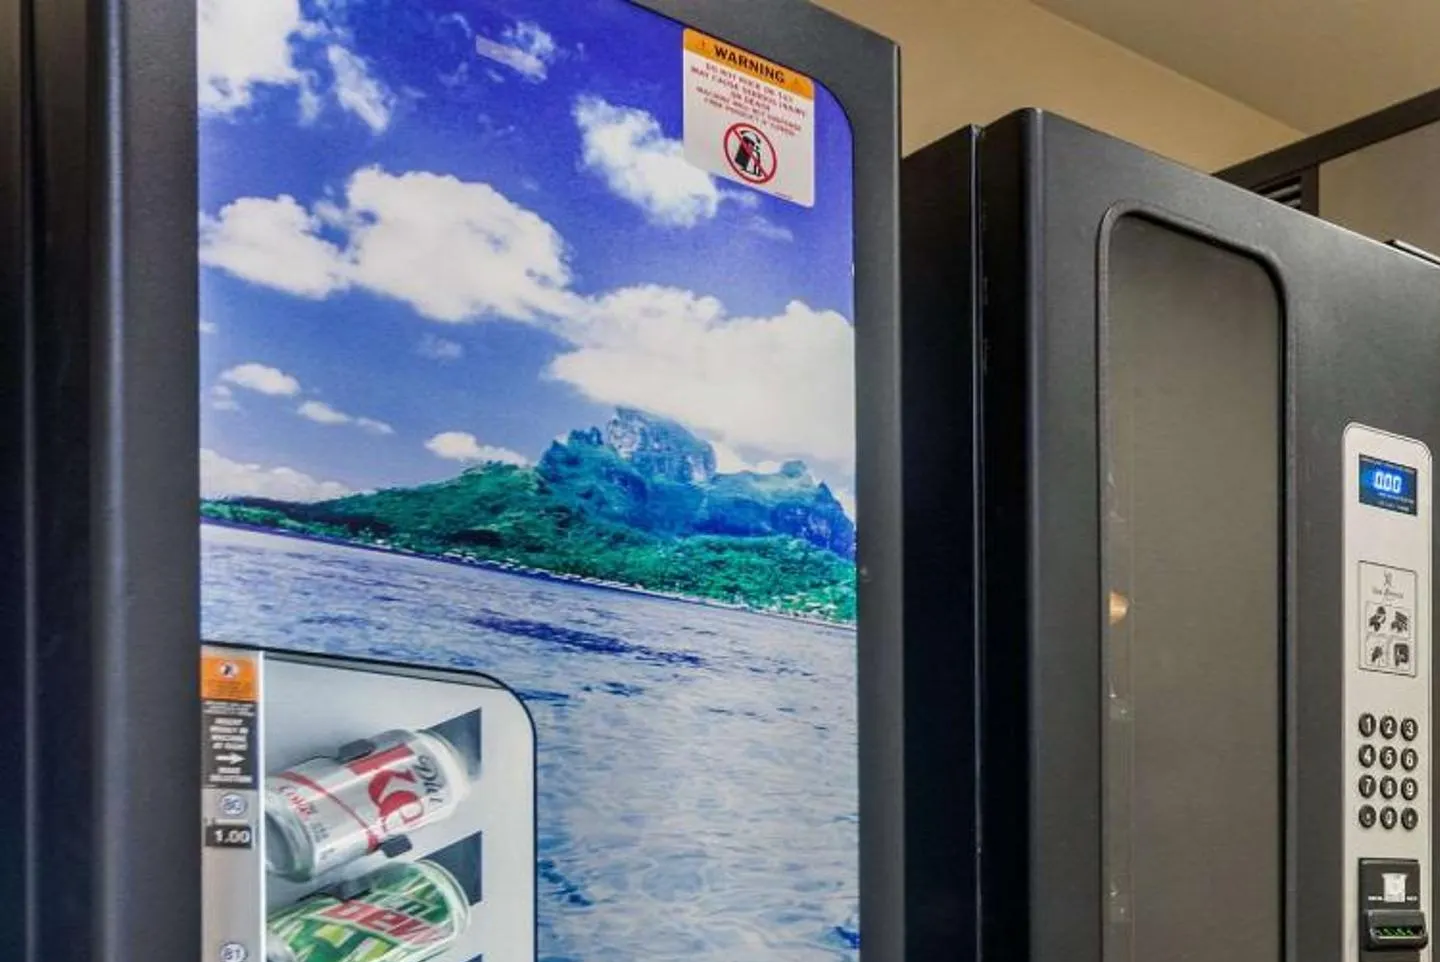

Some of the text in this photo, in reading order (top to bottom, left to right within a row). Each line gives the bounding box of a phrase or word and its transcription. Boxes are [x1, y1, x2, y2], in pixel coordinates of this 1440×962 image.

[714, 44, 784, 84] WARNING
[1385, 720, 1393, 734] 2
[1406, 721, 1414, 736] 3
[1406, 752, 1414, 767] 6
[1406, 782, 1414, 797] 9
[215, 829, 251, 844] 1.00
